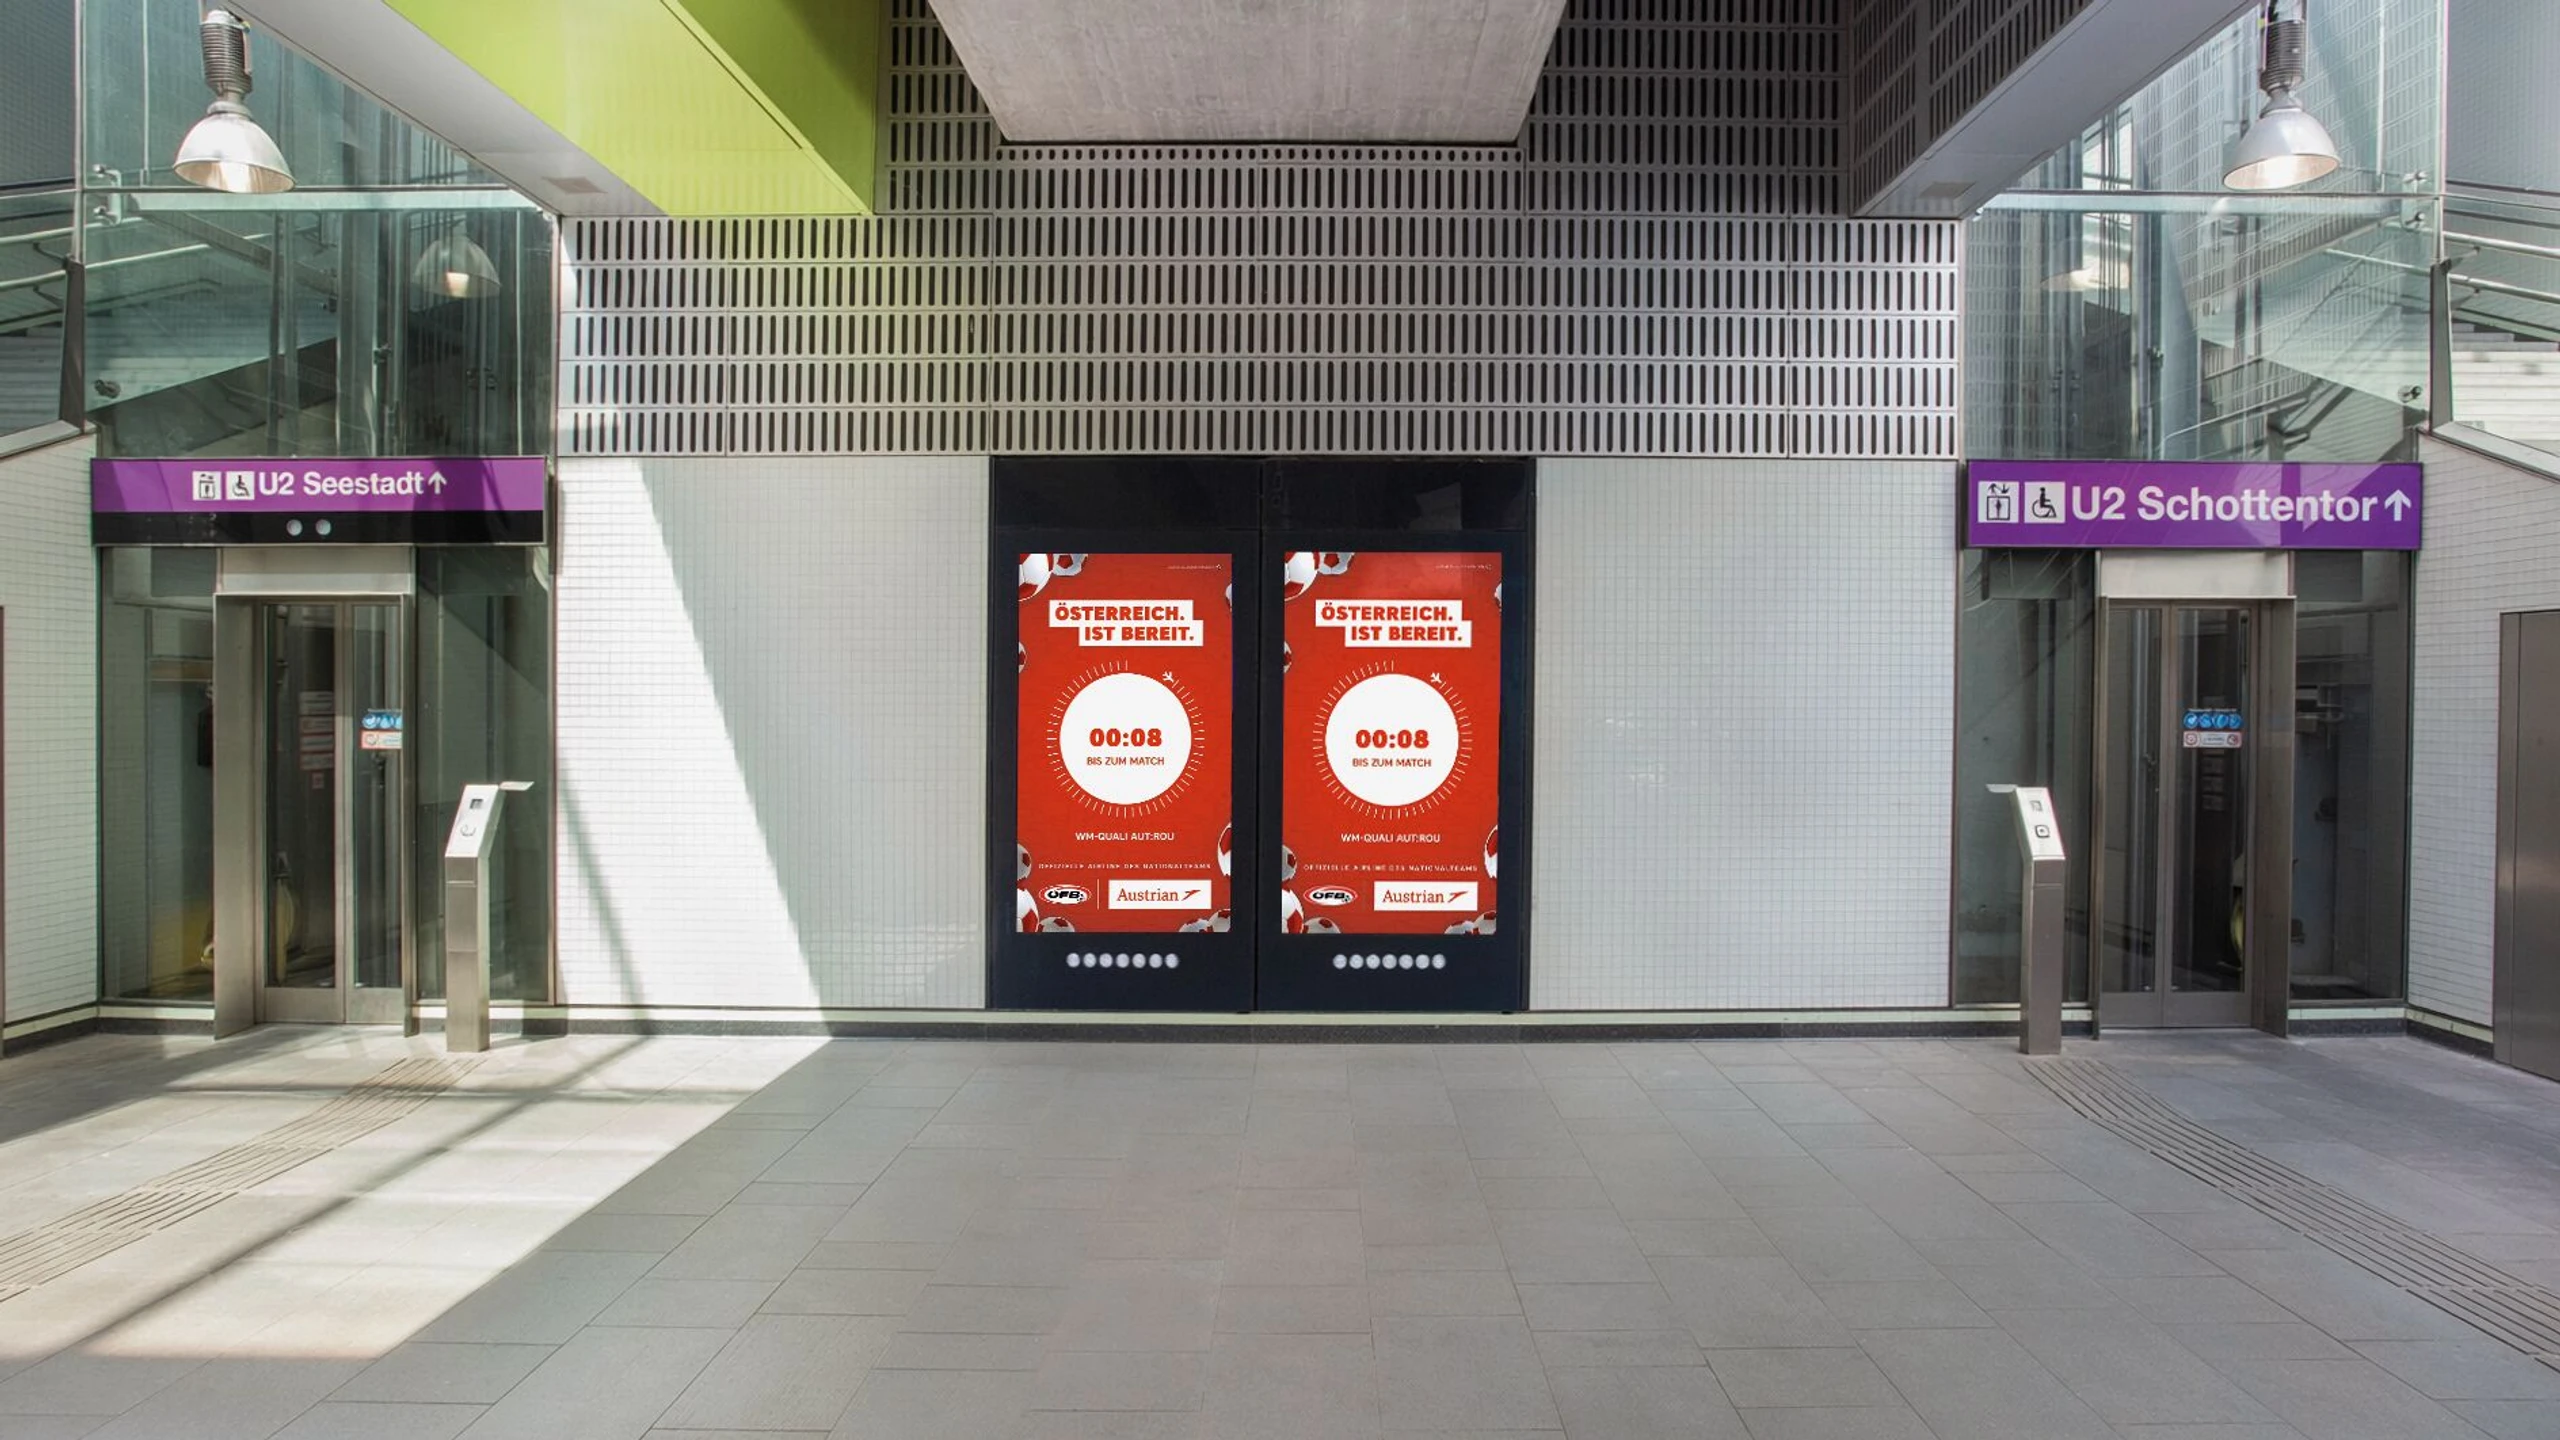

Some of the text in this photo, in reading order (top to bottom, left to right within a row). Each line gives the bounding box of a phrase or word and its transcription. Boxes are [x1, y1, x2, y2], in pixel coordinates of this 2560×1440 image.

[259, 471, 424, 496] U2 Seestadt
[2072, 485, 2378, 522] U2 Schottentor
[1055, 602, 1185, 621] ÖSTERREICH.
[1321, 602, 1453, 621] ÖSTERREICH.
[1084, 626, 1194, 641] IST BEREIT.
[1351, 626, 1462, 642] IST BEREIT.
[1089, 728, 1163, 747] 00:08
[1355, 729, 1430, 749] 00:08
[1086, 757, 1165, 766] BIS ZUM MATCH
[1352, 758, 1432, 767] BIS ZUM MATCH
[1075, 832, 1175, 841] WM-QUALI AUT:ROU
[1340, 833, 1441, 843] WM-QUALI AUT:ROU
[1116, 888, 1179, 902] Austrian
[1382, 889, 1445, 903] Austrian
